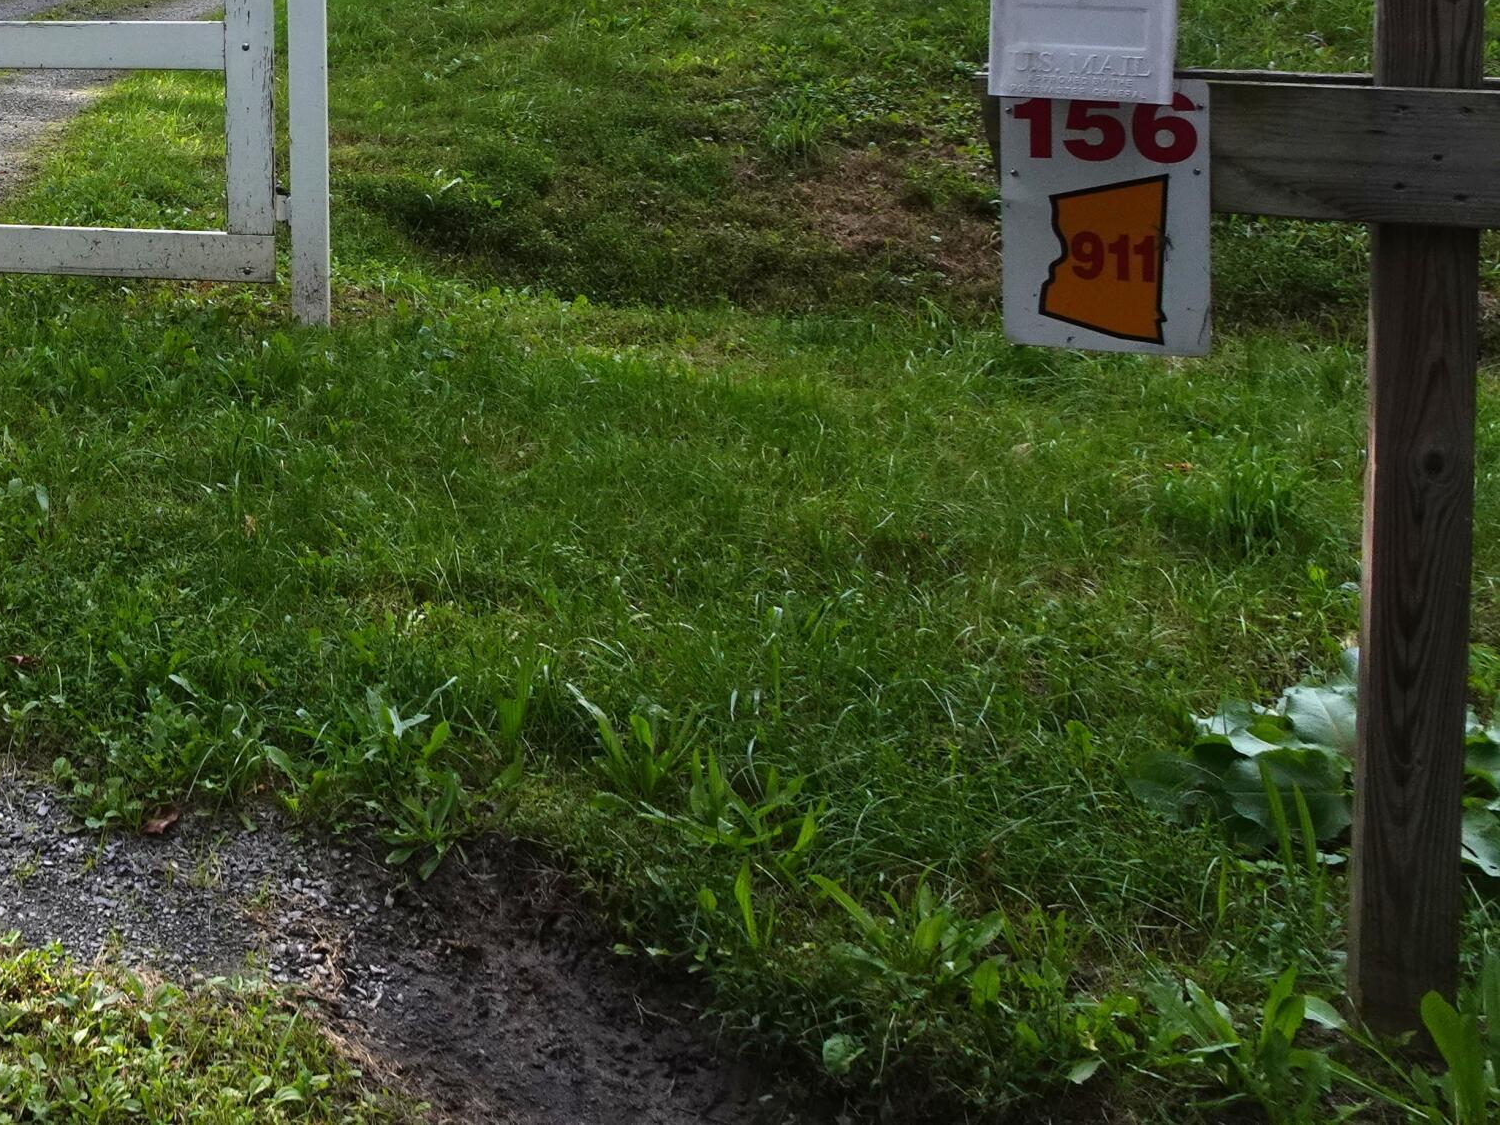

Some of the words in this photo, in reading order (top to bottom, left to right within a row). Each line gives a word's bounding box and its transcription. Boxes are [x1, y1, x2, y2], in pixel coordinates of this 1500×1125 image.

[1069, 52, 1151, 77] MAIL
[1013, 92, 1198, 164] 156
[1071, 230, 1156, 283] 911
